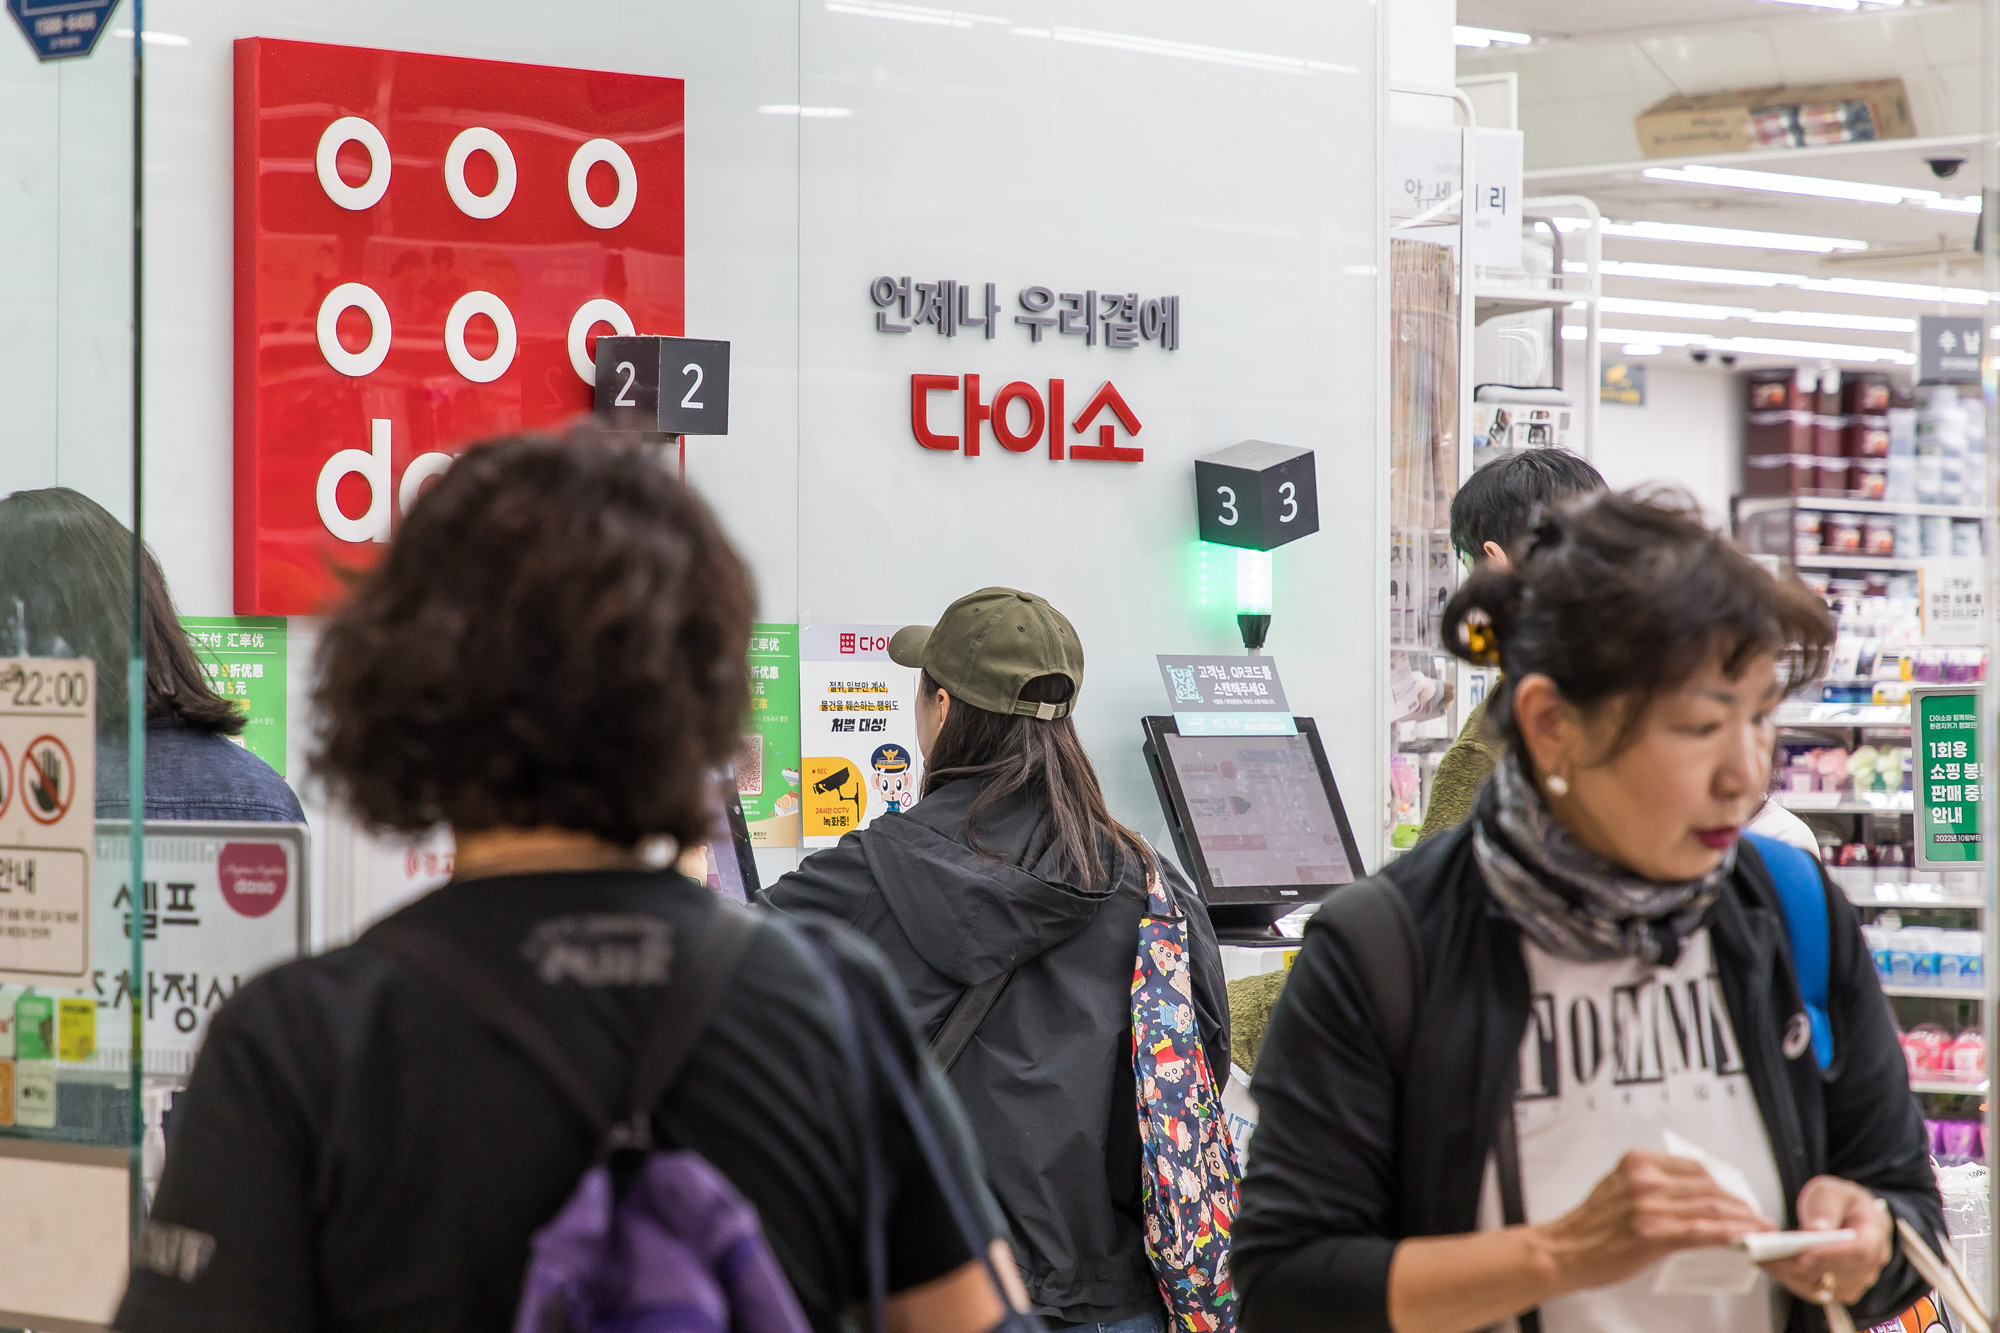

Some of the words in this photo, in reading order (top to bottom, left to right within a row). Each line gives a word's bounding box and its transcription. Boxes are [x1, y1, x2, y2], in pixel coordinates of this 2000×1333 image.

[871, 276, 1001, 340] 언제나
[1015, 285, 1180, 350] 우리곁에
[615, 361, 636, 407] 2
[681, 363, 704, 409] 2
[911, 374, 1144, 462] 다이소
[1217, 486, 1239, 527] 3
[1279, 482, 1298, 524] 3
[227, 633, 265, 648] 汇率优
[1198, 665, 1230, 680] 고객님,
[1230, 665, 1272, 680] QR코드를
[1213, 682, 1269, 697] 스캔해주세요
[821, 700, 844, 712] 물건을
[845, 700, 875, 712] 훼손하는
[876, 700, 900, 712] 행위도
[831, 718, 856, 732] 처벌
[859, 718, 887, 732] 대상!
[1929, 741, 1967, 758] 1회용
[1930, 763, 1960, 780] 쇼핑
[1931, 785, 1962, 802] 판매
[823, 816, 850, 827] 녹화중!
[1932, 807, 1963, 824] 안내
